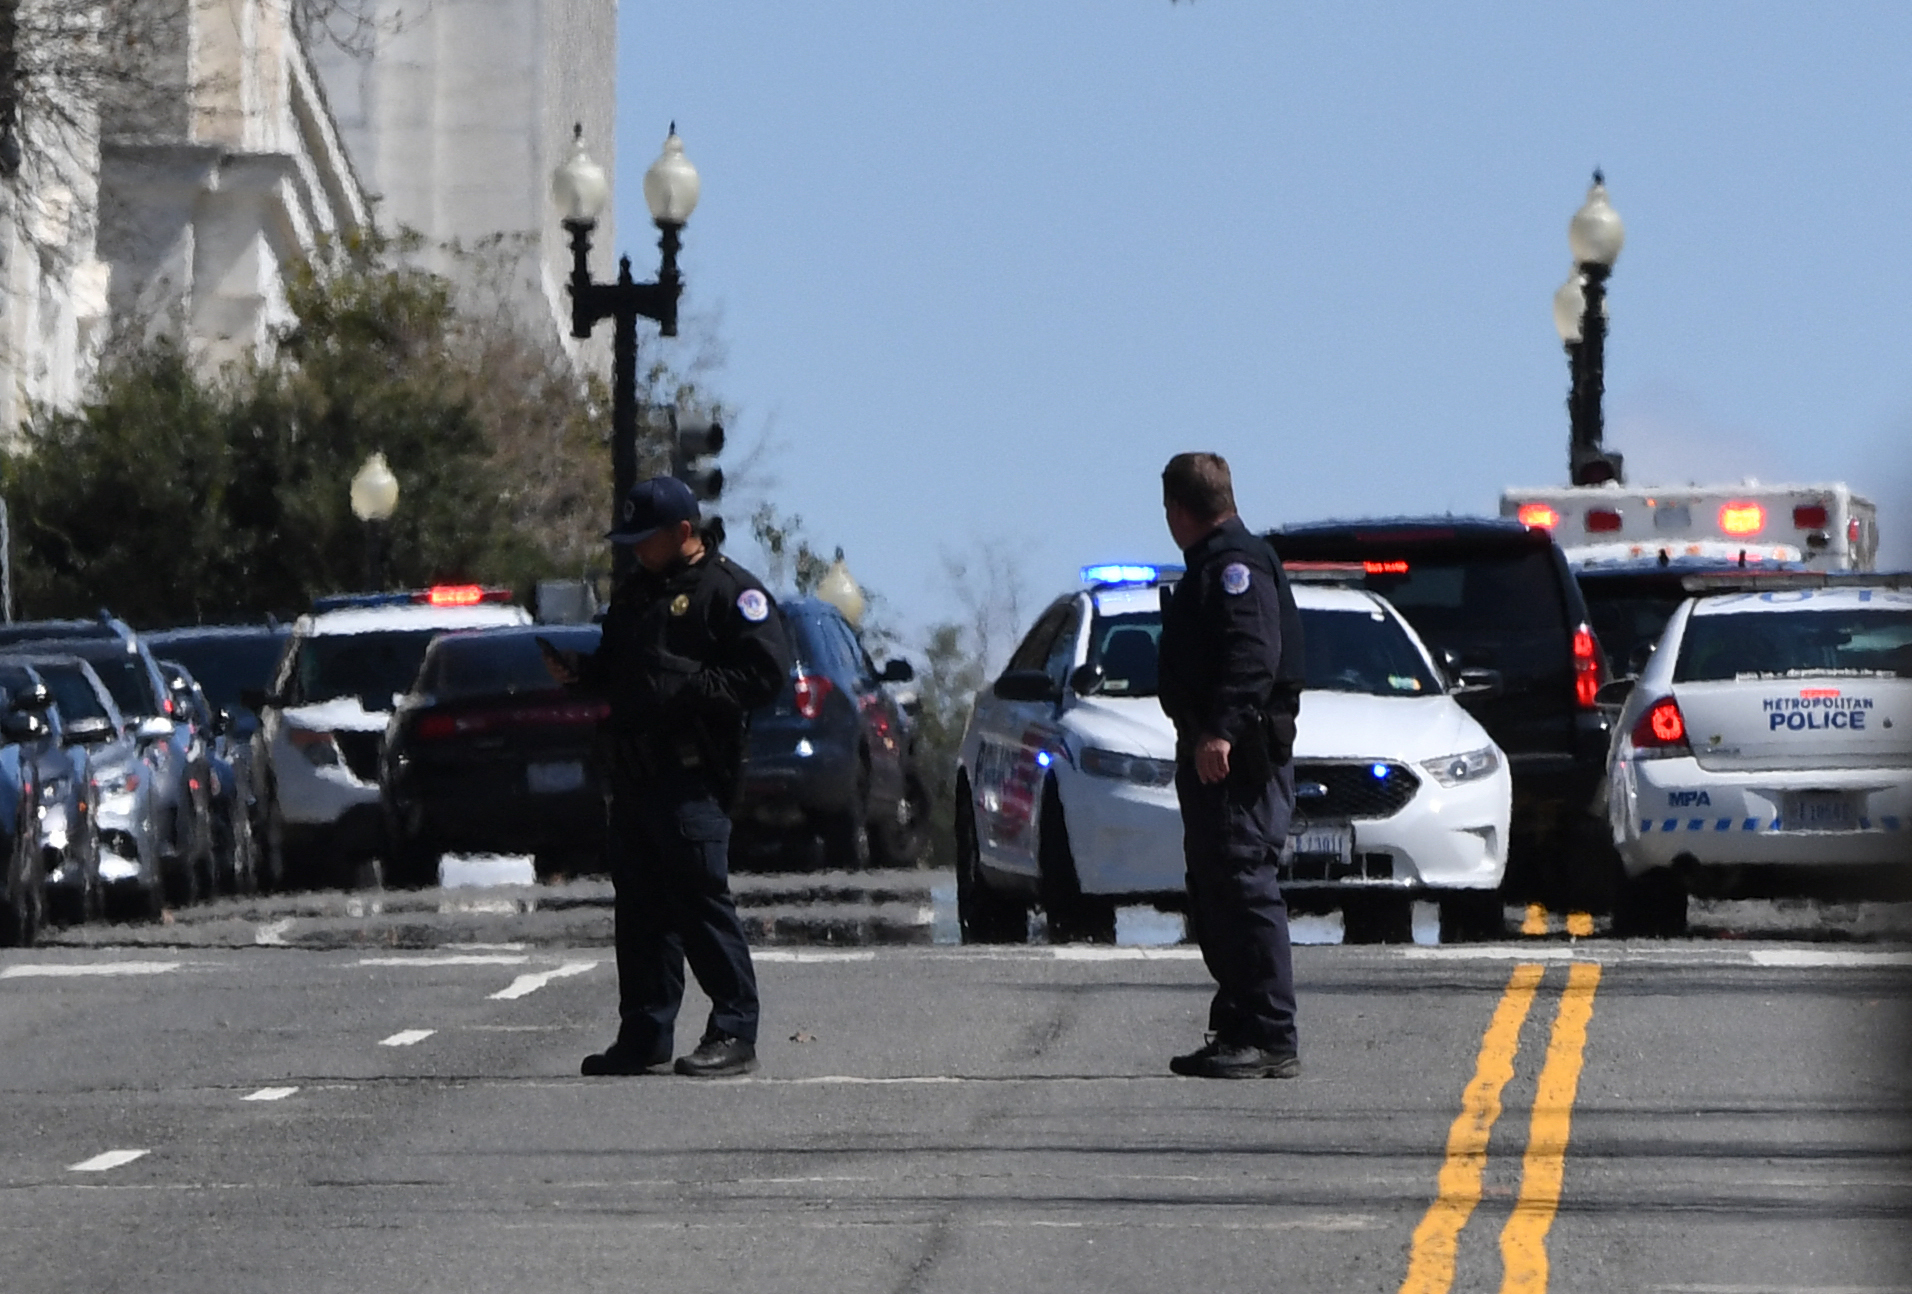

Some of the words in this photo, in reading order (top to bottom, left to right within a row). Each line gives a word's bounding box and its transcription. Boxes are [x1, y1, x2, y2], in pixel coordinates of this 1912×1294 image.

[1763, 697, 1873, 711] METROPOLITAN
[1769, 711, 1866, 732] POLICE
[1668, 791, 1711, 807] MPA
